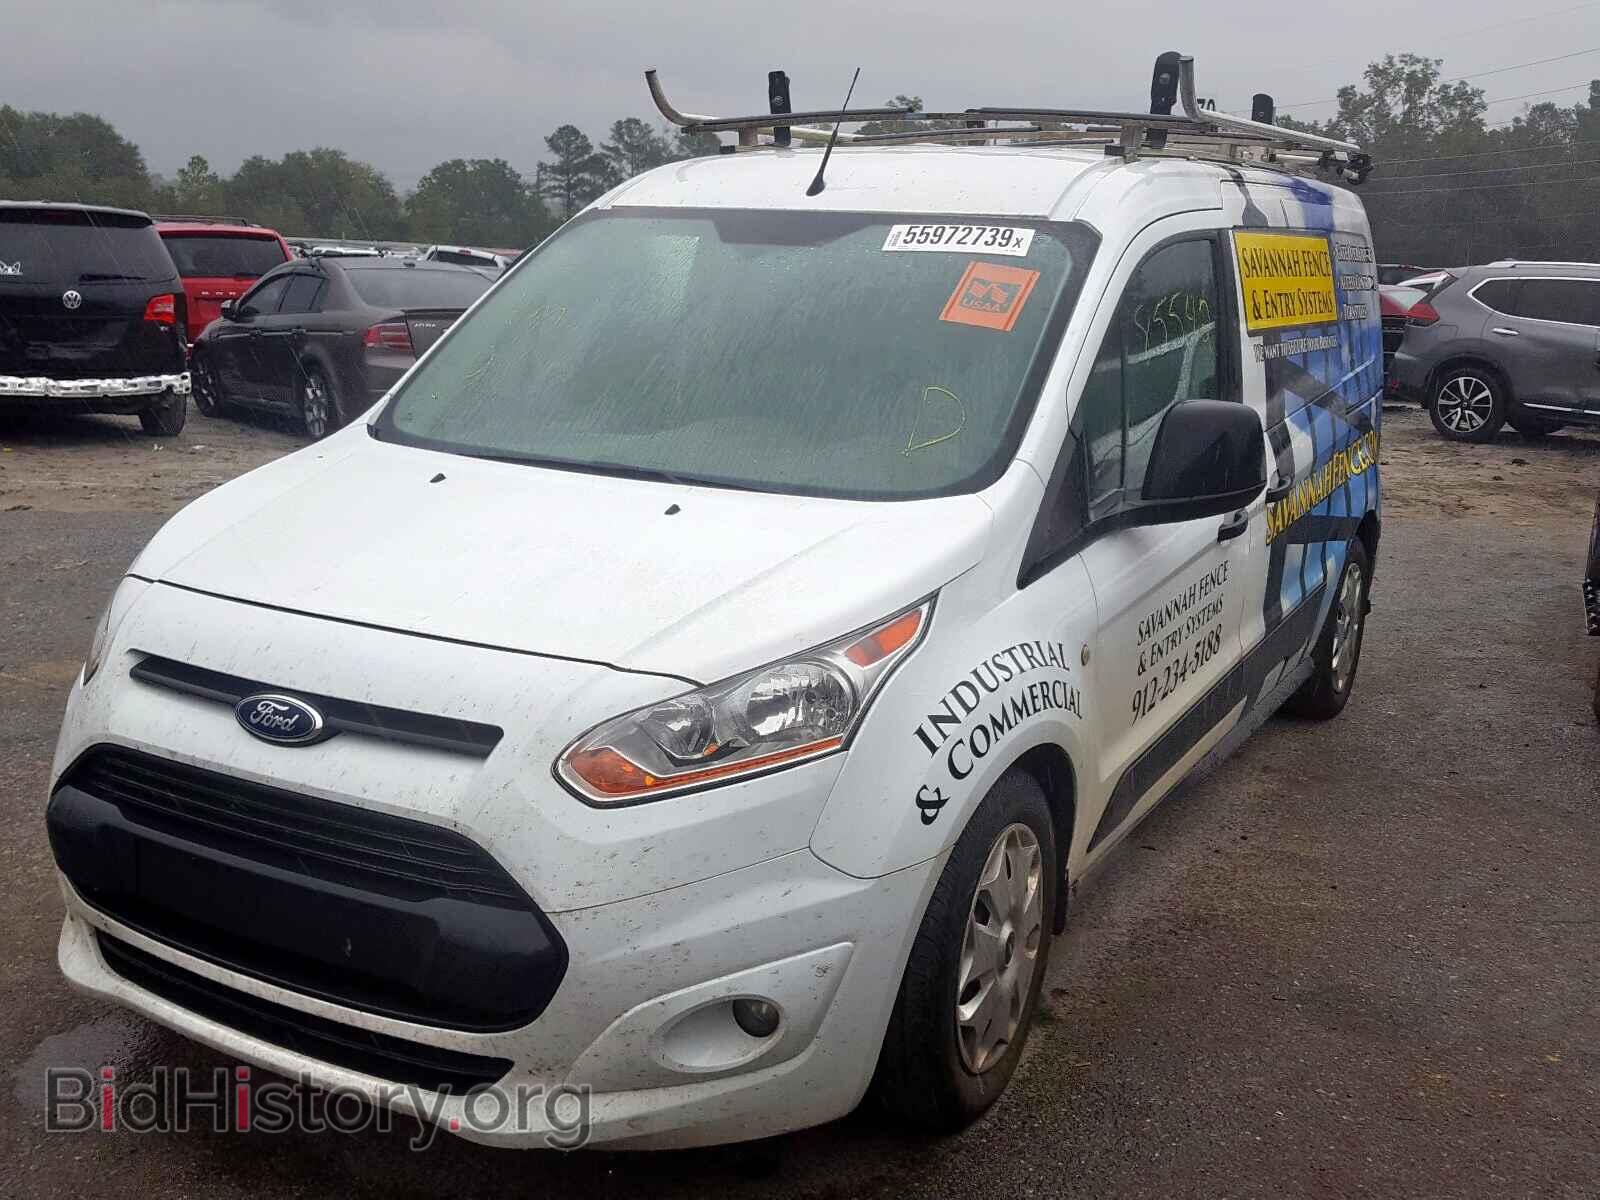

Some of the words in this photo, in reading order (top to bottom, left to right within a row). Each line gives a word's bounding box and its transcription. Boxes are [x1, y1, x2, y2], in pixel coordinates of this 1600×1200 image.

[1242, 248, 1300, 278] SAVANNAH
[1303, 250, 1332, 278] FENCE
[1252, 290, 1262, 320] &
[1263, 290, 1297, 318] ENTRY
[1297, 288, 1333, 316] SYSTEMS
[1137, 584, 1196, 646] SAVANNAH
[1199, 560, 1229, 597] FENCE
[1137, 651, 1147, 676] &
[1150, 624, 1184, 668] ENTRY
[1184, 593, 1224, 640] SYSTEMS
[249, 700, 300, 731] Ford
[913, 641, 1070, 759] INDUSTRIAL
[1131, 623, 1222, 727] 912-234-5188
[915, 784, 951, 826] &
[947, 679, 1083, 780] COMMERCIAL
